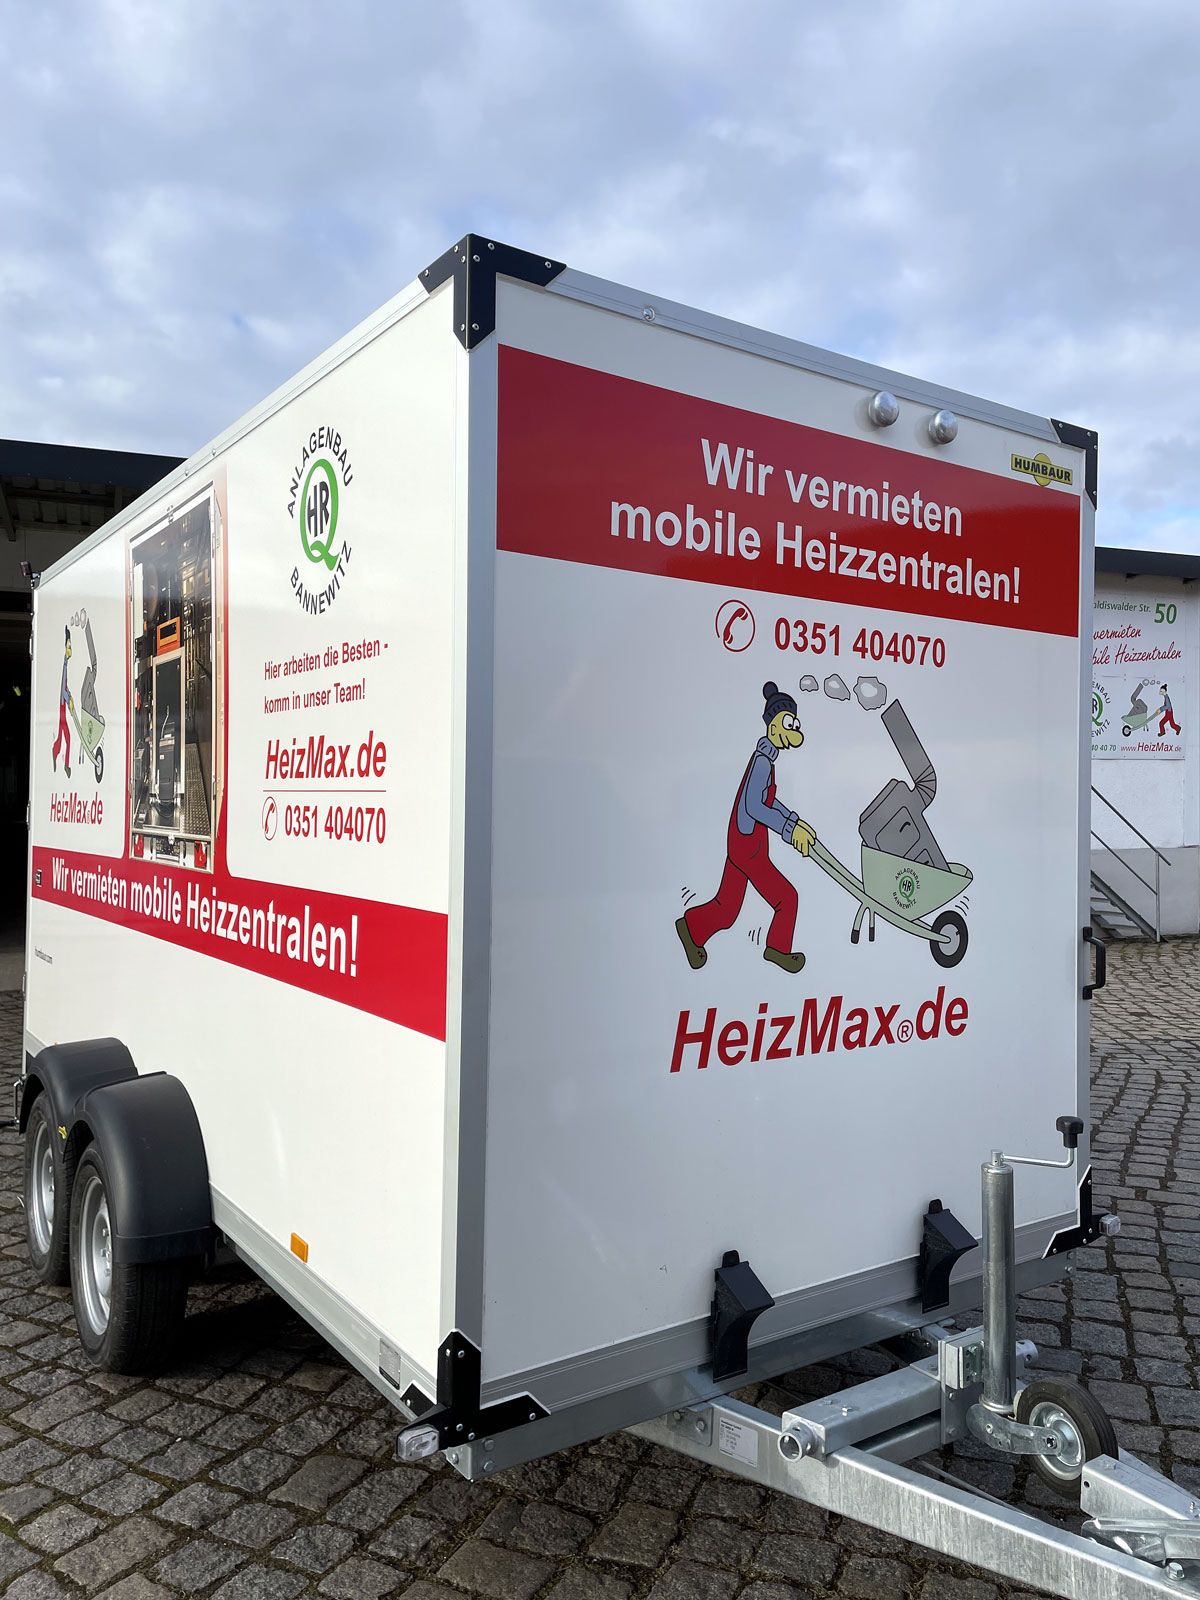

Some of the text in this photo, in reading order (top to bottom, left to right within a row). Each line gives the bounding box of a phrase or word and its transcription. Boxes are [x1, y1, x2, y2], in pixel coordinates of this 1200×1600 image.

[287, 426, 353, 519] ANLAGENBAU
[701, 438, 963, 536] Wir vermieten
[1014, 457, 1071, 481] HUMBAUR
[610, 501, 1021, 604] mobile Heizzentralen!
[290, 540, 352, 616] BANNEWITZ
[1139, 603, 1151, 613] Str.
[1154, 603, 1177, 625] 50
[264, 661, 281, 681] Hier
[283, 651, 320, 677] arbeiten
[323, 646, 339, 667] die
[342, 639, 380, 664] Besten
[774, 616, 946, 669] 0351 404070
[1115, 641, 1181, 664] Heizzentralen
[264, 678, 365, 714] komm in unser Team!
[265, 730, 387, 779] HeizMax.de
[284, 804, 386, 844] 0351 404070
[52, 857, 359, 978] Wir vermieten mobile Heizzentralen!
